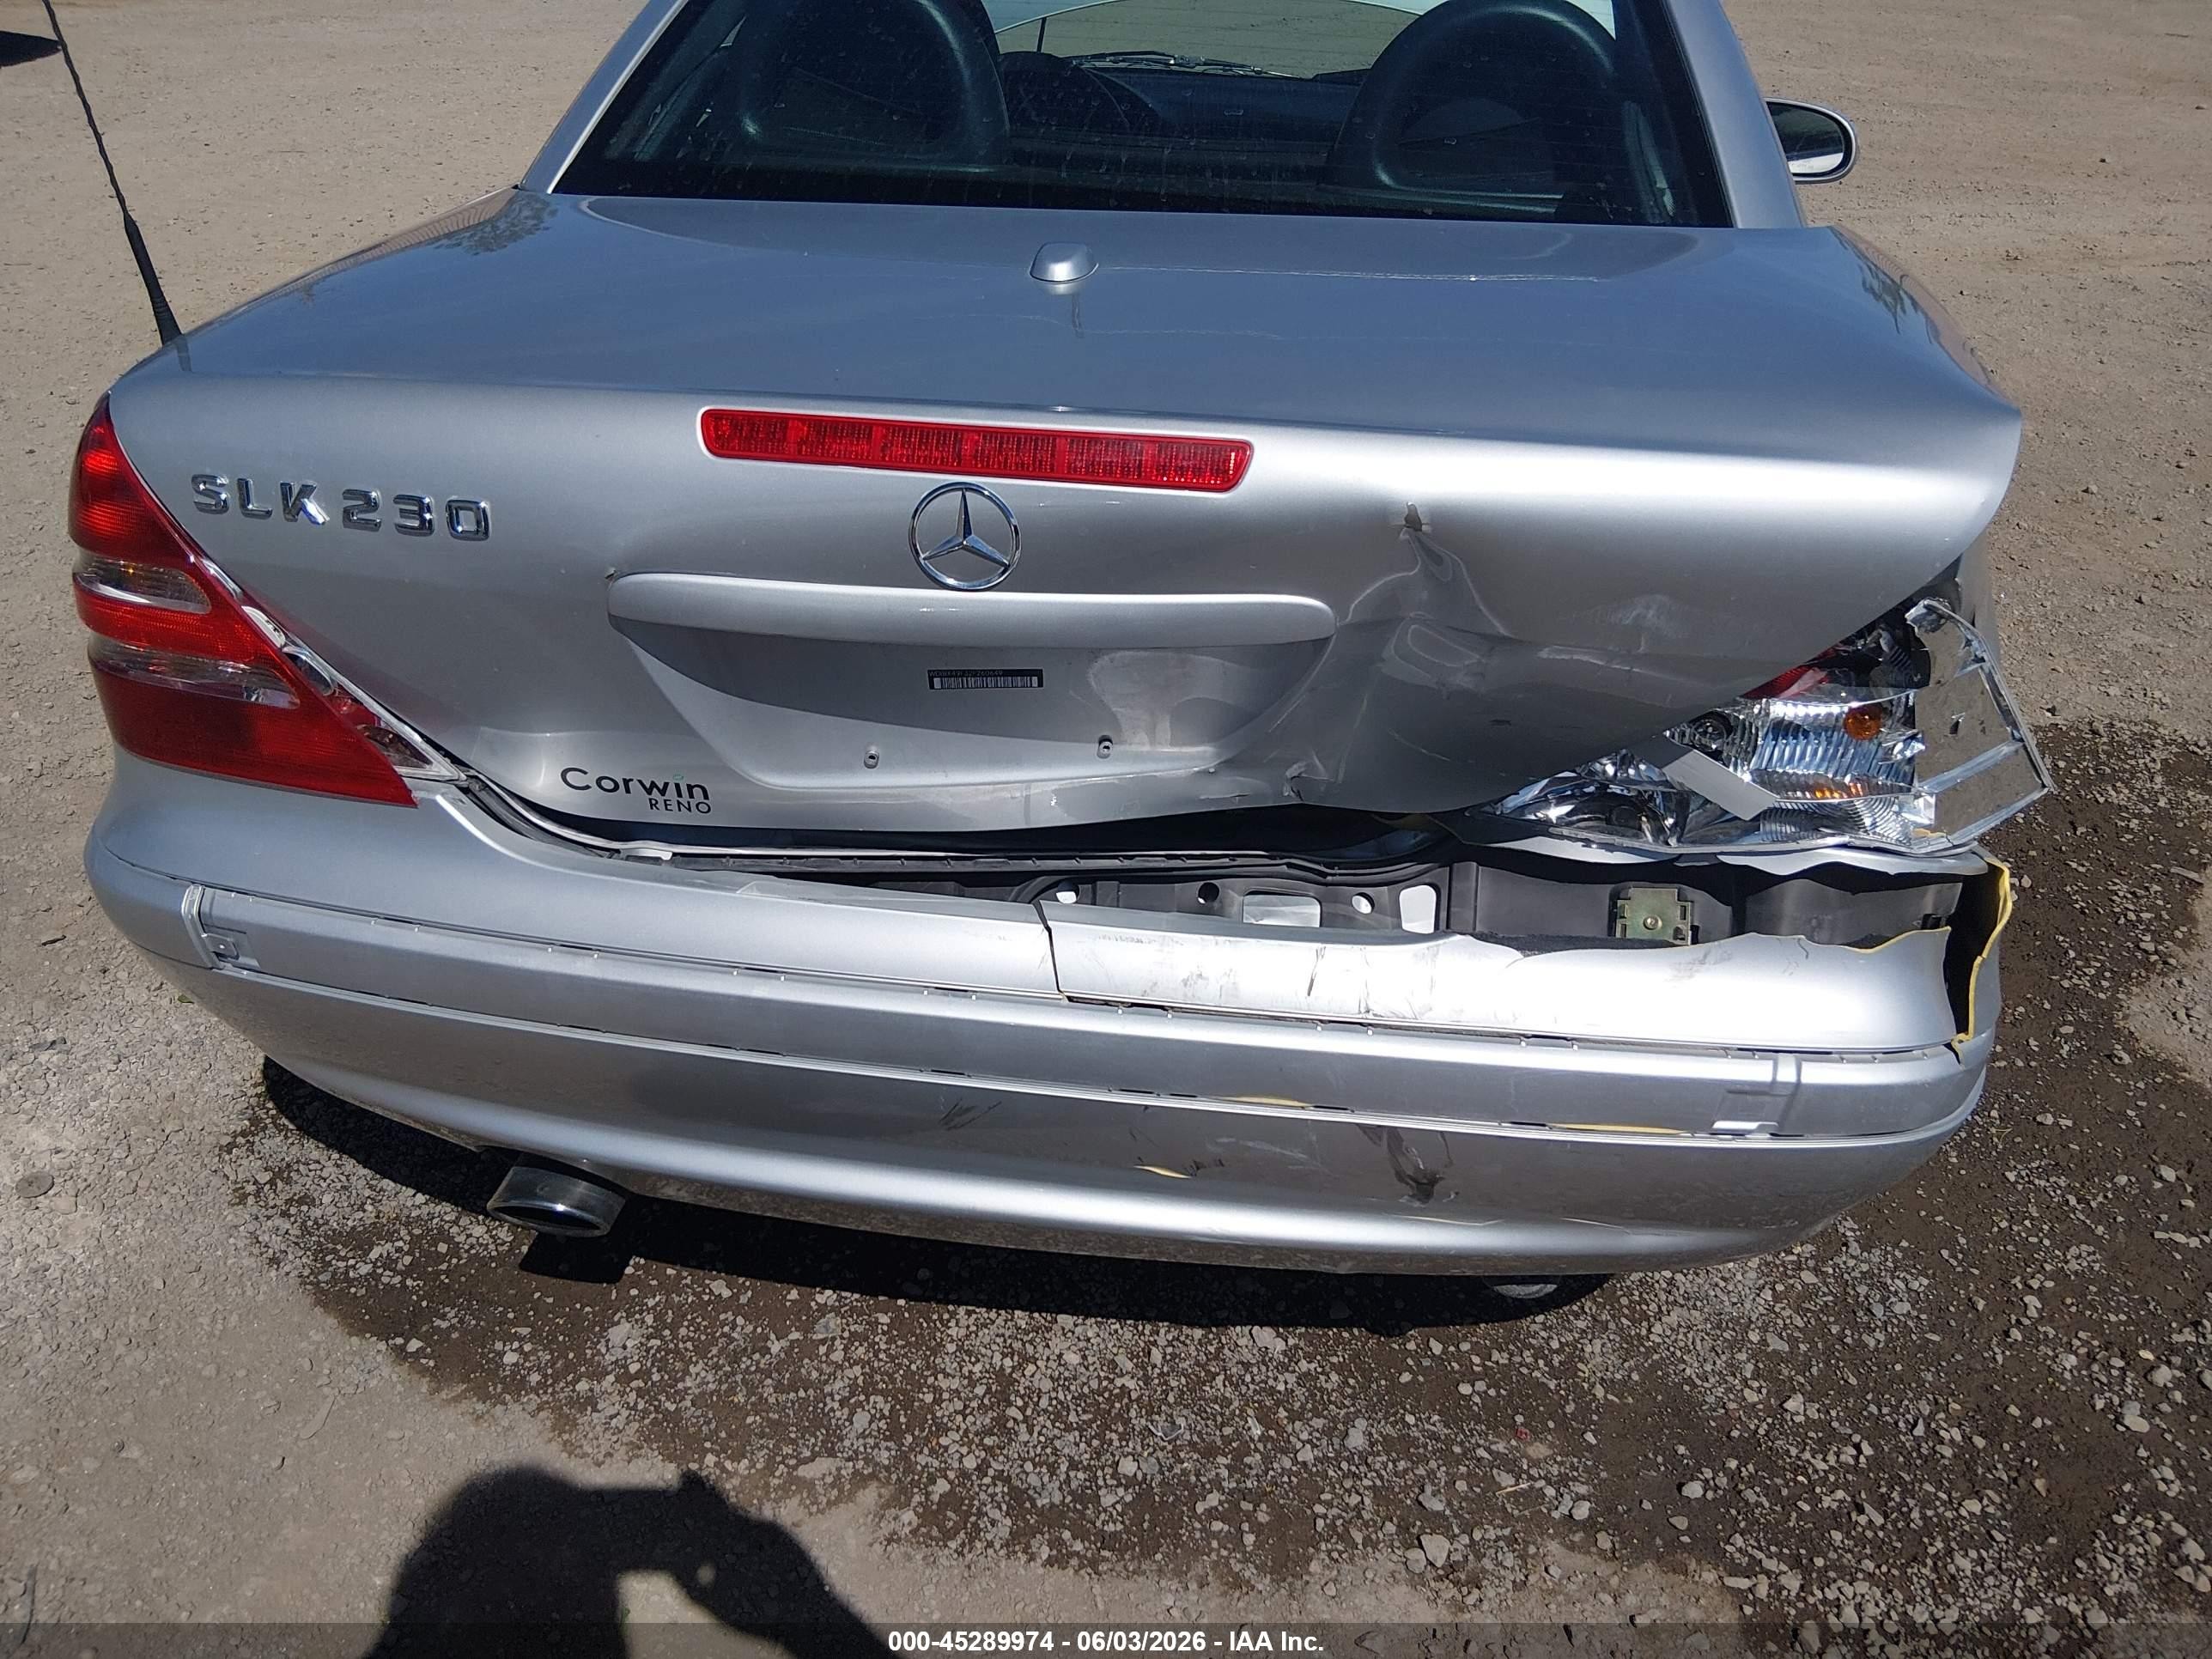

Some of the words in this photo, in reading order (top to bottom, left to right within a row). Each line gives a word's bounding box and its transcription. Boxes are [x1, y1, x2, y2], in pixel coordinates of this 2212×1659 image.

[191, 473, 330, 526] SLK
[341, 488, 493, 542] 230
[561, 767, 710, 800] Corwin
[648, 798, 712, 814] RENO
